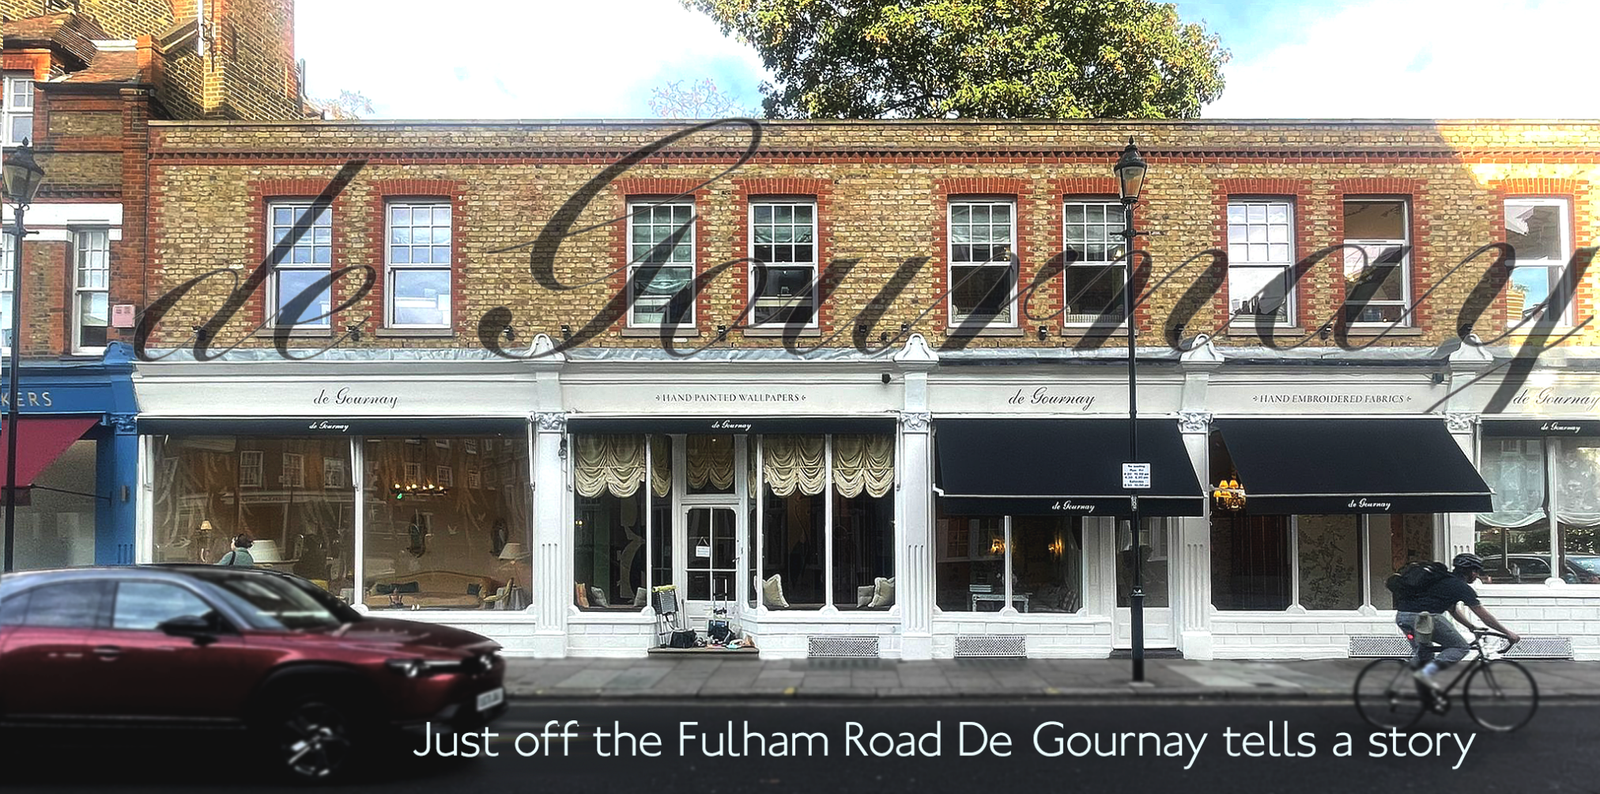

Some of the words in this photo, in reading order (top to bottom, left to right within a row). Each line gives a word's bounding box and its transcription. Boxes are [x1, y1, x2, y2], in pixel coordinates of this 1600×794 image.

[313, 389, 330, 405] de
[335, 386, 399, 409] Gournay
[662, 394, 692, 402] HAND
[694, 393, 736, 402] PAINTED
[738, 393, 800, 402] WALLPAPERS
[1008, 388, 1025, 405] de
[1030, 386, 1096, 412] Gournay
[1259, 394, 1290, 403] HAND
[1292, 394, 1363, 404] EMBROIDERED
[1364, 394, 1405, 404] FABRICS
[1513, 388, 1530, 405] de
[1535, 386, 1600, 412] Gournay
[319, 420, 349, 432] Gournay
[721, 419, 751, 431] Gournay
[1550, 421, 1580, 433] Gournay
[1062, 499, 1095, 513] Gournay
[1358, 497, 1391, 510] Gournay
